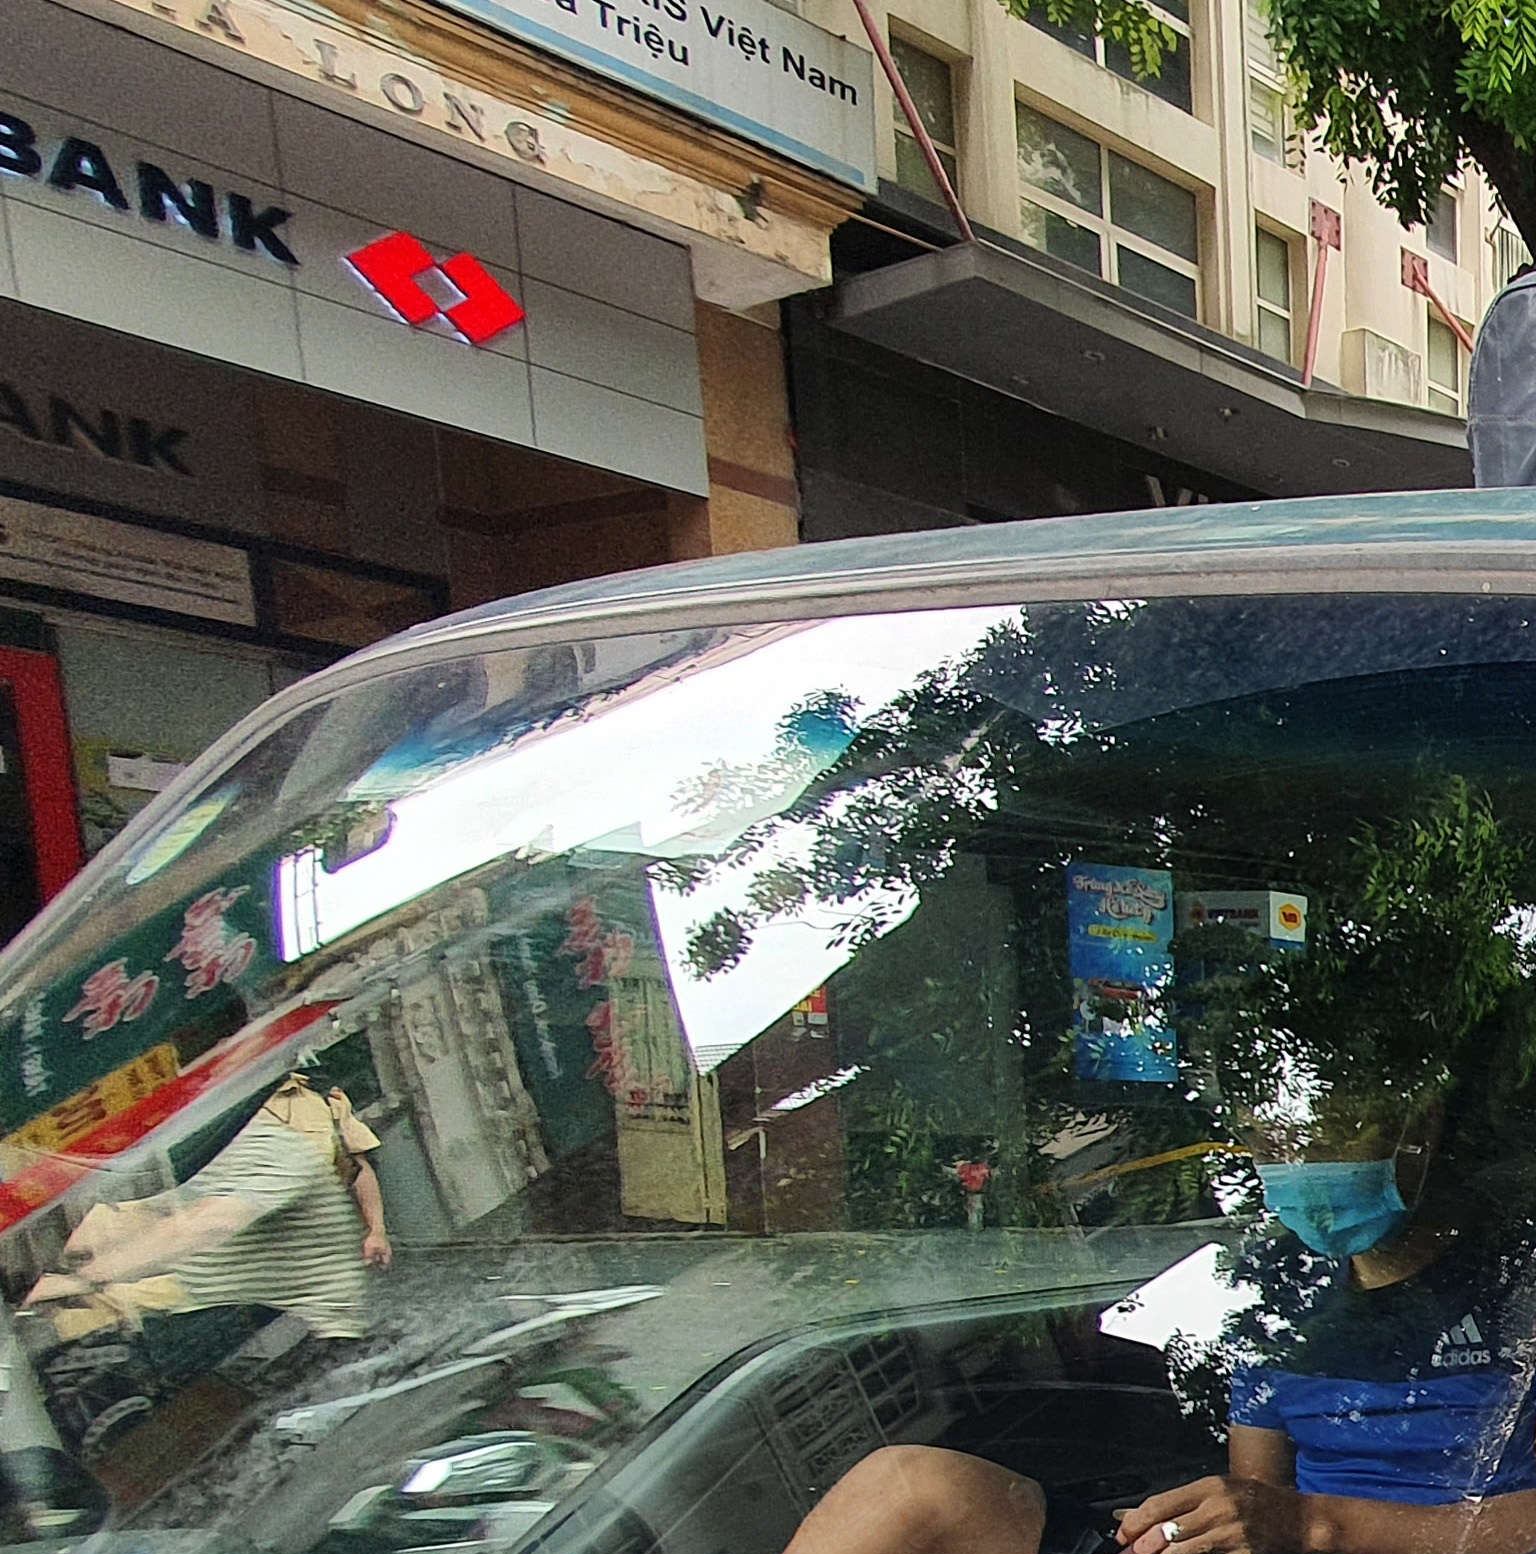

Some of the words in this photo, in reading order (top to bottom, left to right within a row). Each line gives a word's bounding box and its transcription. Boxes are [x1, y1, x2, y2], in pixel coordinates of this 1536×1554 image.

[597, 1, 690, 66] Triệu
[700, 6, 770, 61] Việt
[782, 47, 858, 106] Nam
[313, 38, 547, 166] LONG
[1430, 1347, 1492, 1368] adidas
